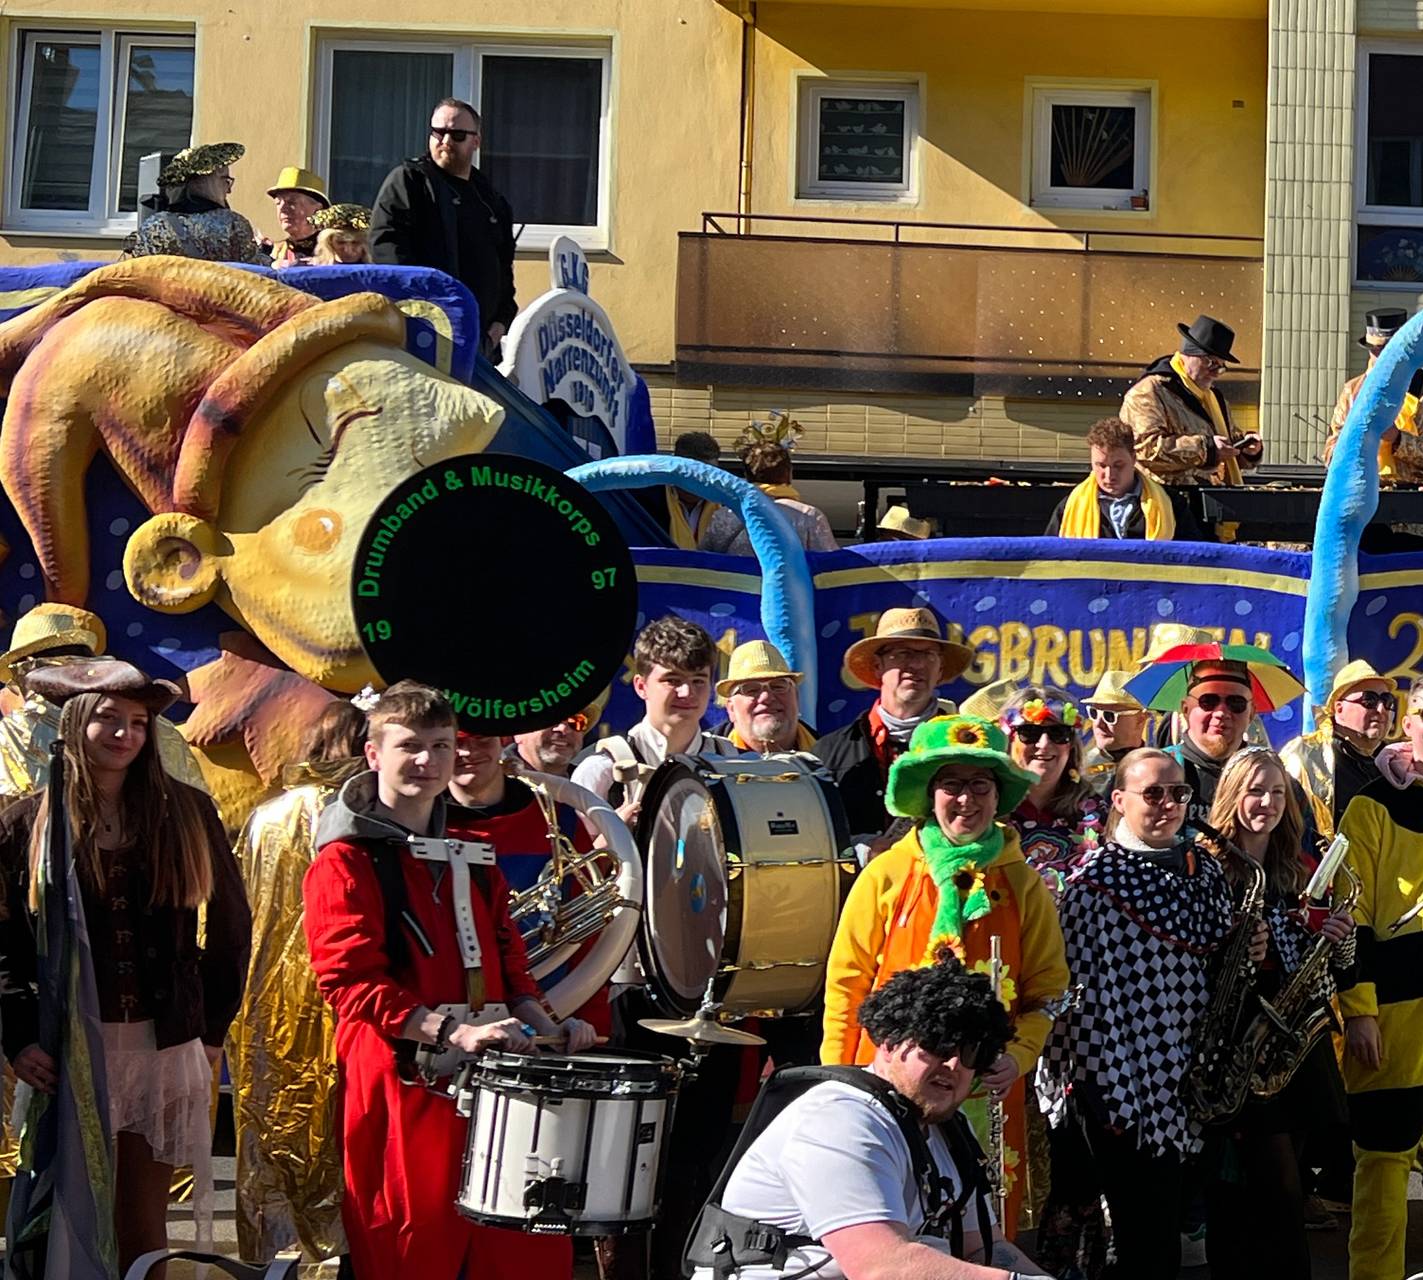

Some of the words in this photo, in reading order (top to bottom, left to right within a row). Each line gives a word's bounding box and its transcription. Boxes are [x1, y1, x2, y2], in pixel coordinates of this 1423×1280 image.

[538, 309, 624, 392] Düsseldorfer
[543, 344, 619, 427] Narrenzunft
[357, 479, 440, 597] Drumband
[444, 469, 464, 491] &
[471, 466, 601, 547] Musikkorps
[591, 567, 617, 590] 97
[362, 619, 392, 643] 19
[444, 658, 596, 720] Wölfersheim
